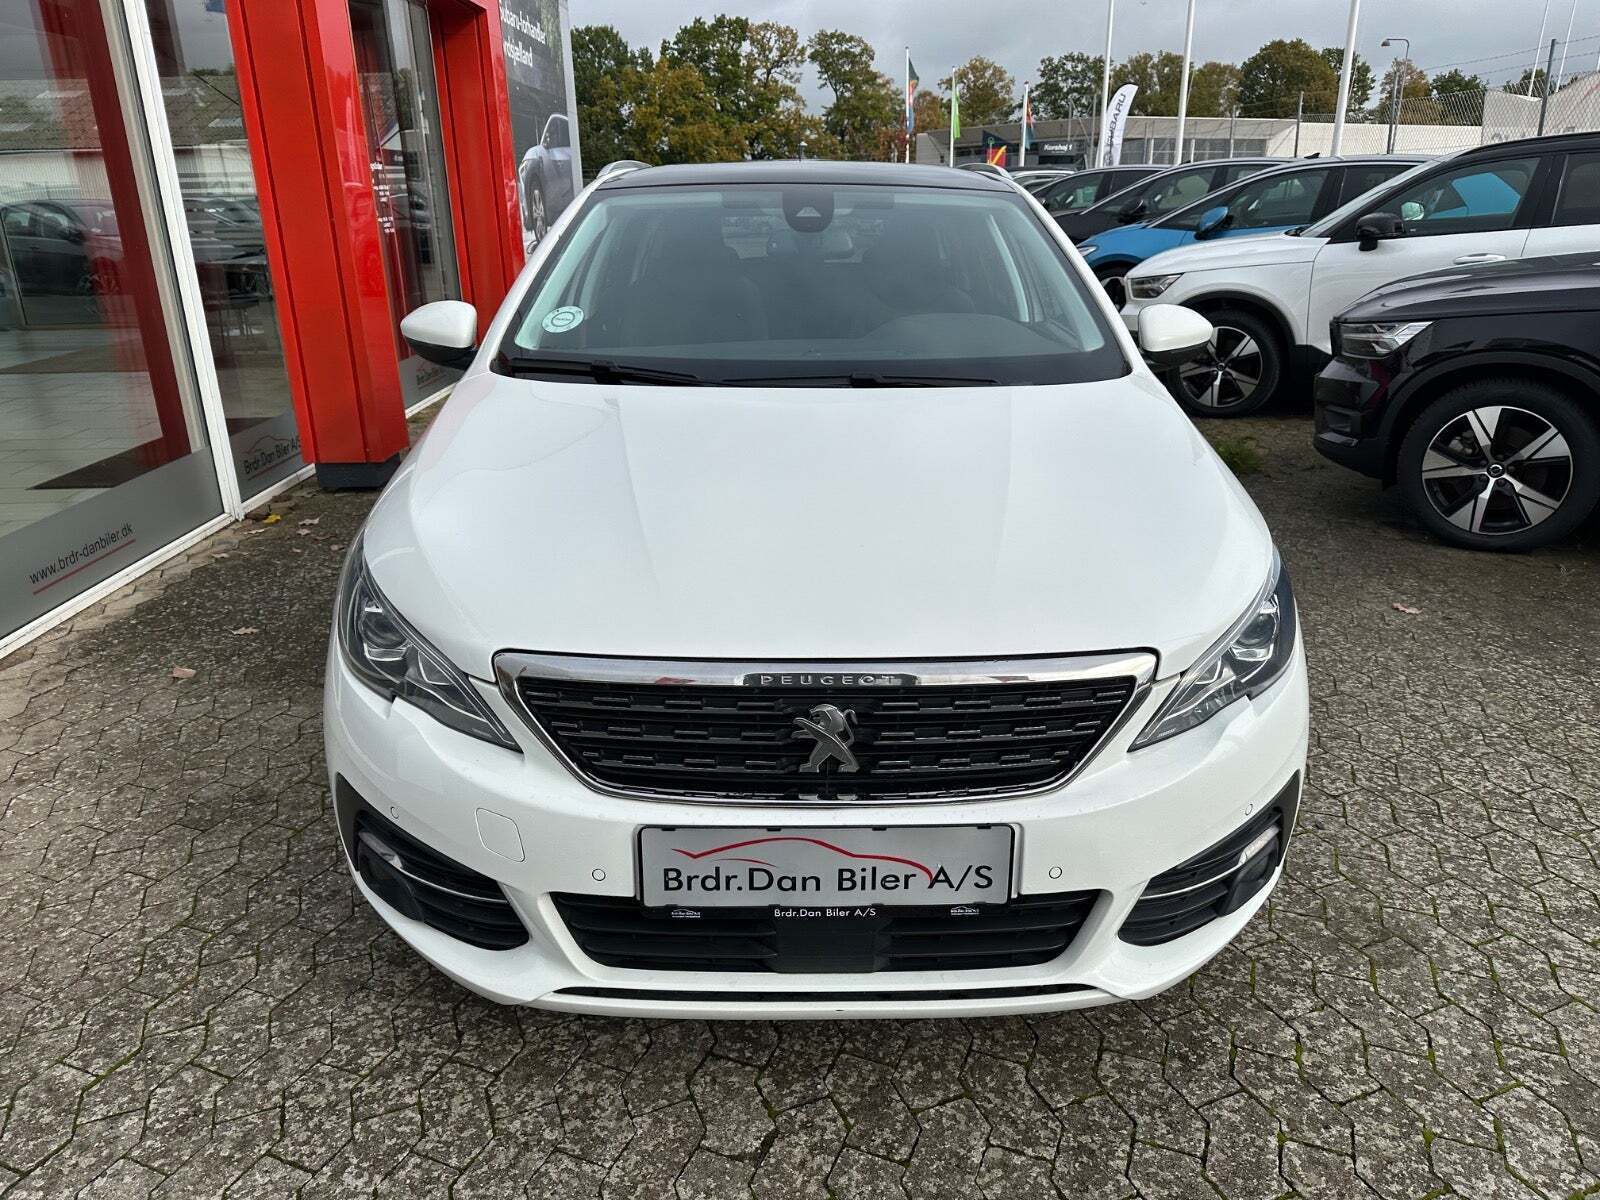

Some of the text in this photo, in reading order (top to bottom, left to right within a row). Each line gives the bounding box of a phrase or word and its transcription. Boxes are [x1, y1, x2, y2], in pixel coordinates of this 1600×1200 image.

[29, 523, 133, 585] www.brdr-danbiler.dk
[760, 674, 896, 686] PEUGEOT
[663, 865, 993, 892] Brdr.Dan Biler A/S
[774, 908, 876, 917] Brdr.Dan Biler A/S
